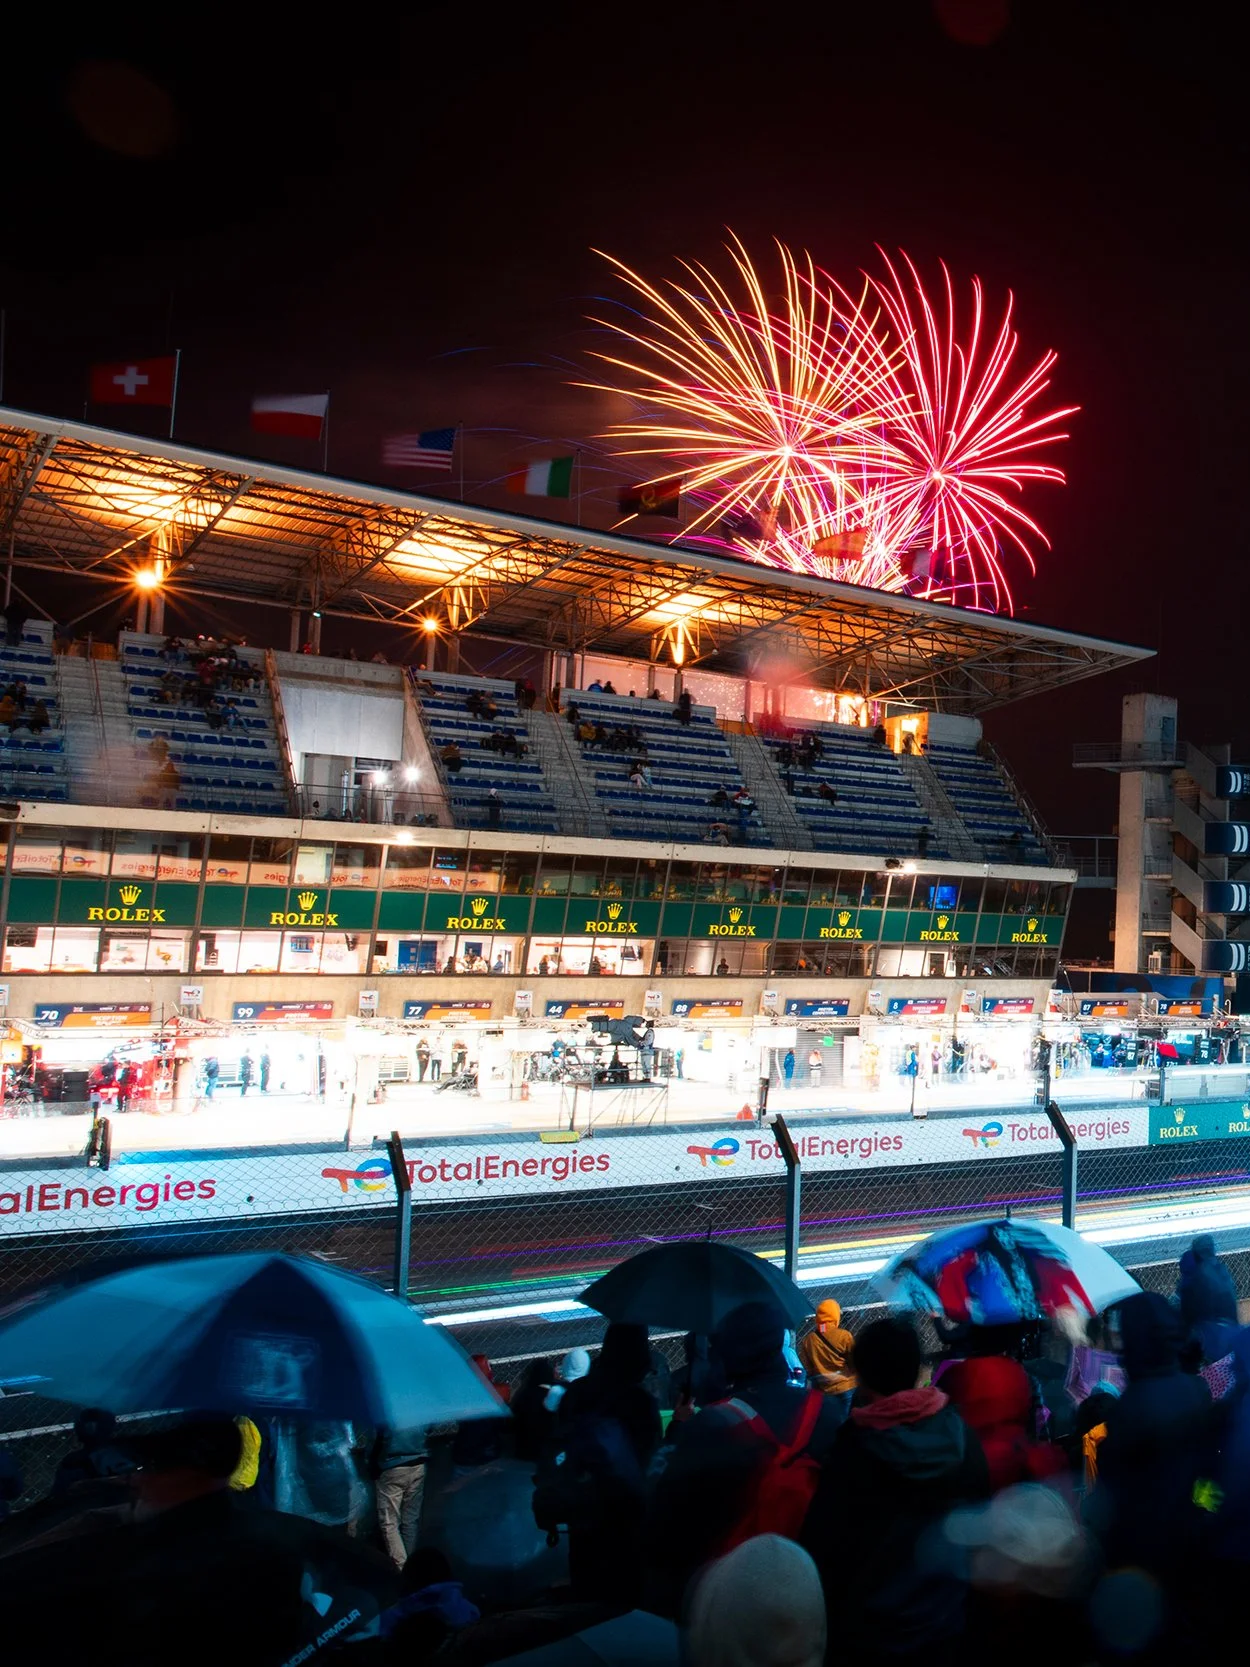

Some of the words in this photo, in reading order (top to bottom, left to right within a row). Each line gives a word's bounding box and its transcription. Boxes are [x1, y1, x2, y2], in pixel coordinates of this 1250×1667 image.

[88, 907, 165, 922] ROLEX
[270, 912, 338, 926] ROLEX
[447, 917, 506, 930] ROLEX
[585, 921, 638, 934] ROLEX
[708, 924, 756, 936] ROLEX
[820, 927, 863, 939] ROLEX
[920, 931, 959, 941] ROLEX
[1011, 933, 1048, 943] ROLEX
[237, 1007, 254, 1018] 99
[408, 1006, 422, 1015] 77
[548, 1005, 563, 1014] 44
[675, 1004, 688, 1012] 88
[791, 1003, 797, 1011] 9
[41, 1010, 59, 1020] 70
[1159, 1125, 1198, 1139] ROLEX
[746, 1132, 903, 1160] TotlEnergies
[404, 1149, 610, 1184] TotalEnergies
[315, 1608, 361, 1648] ARMOUR
